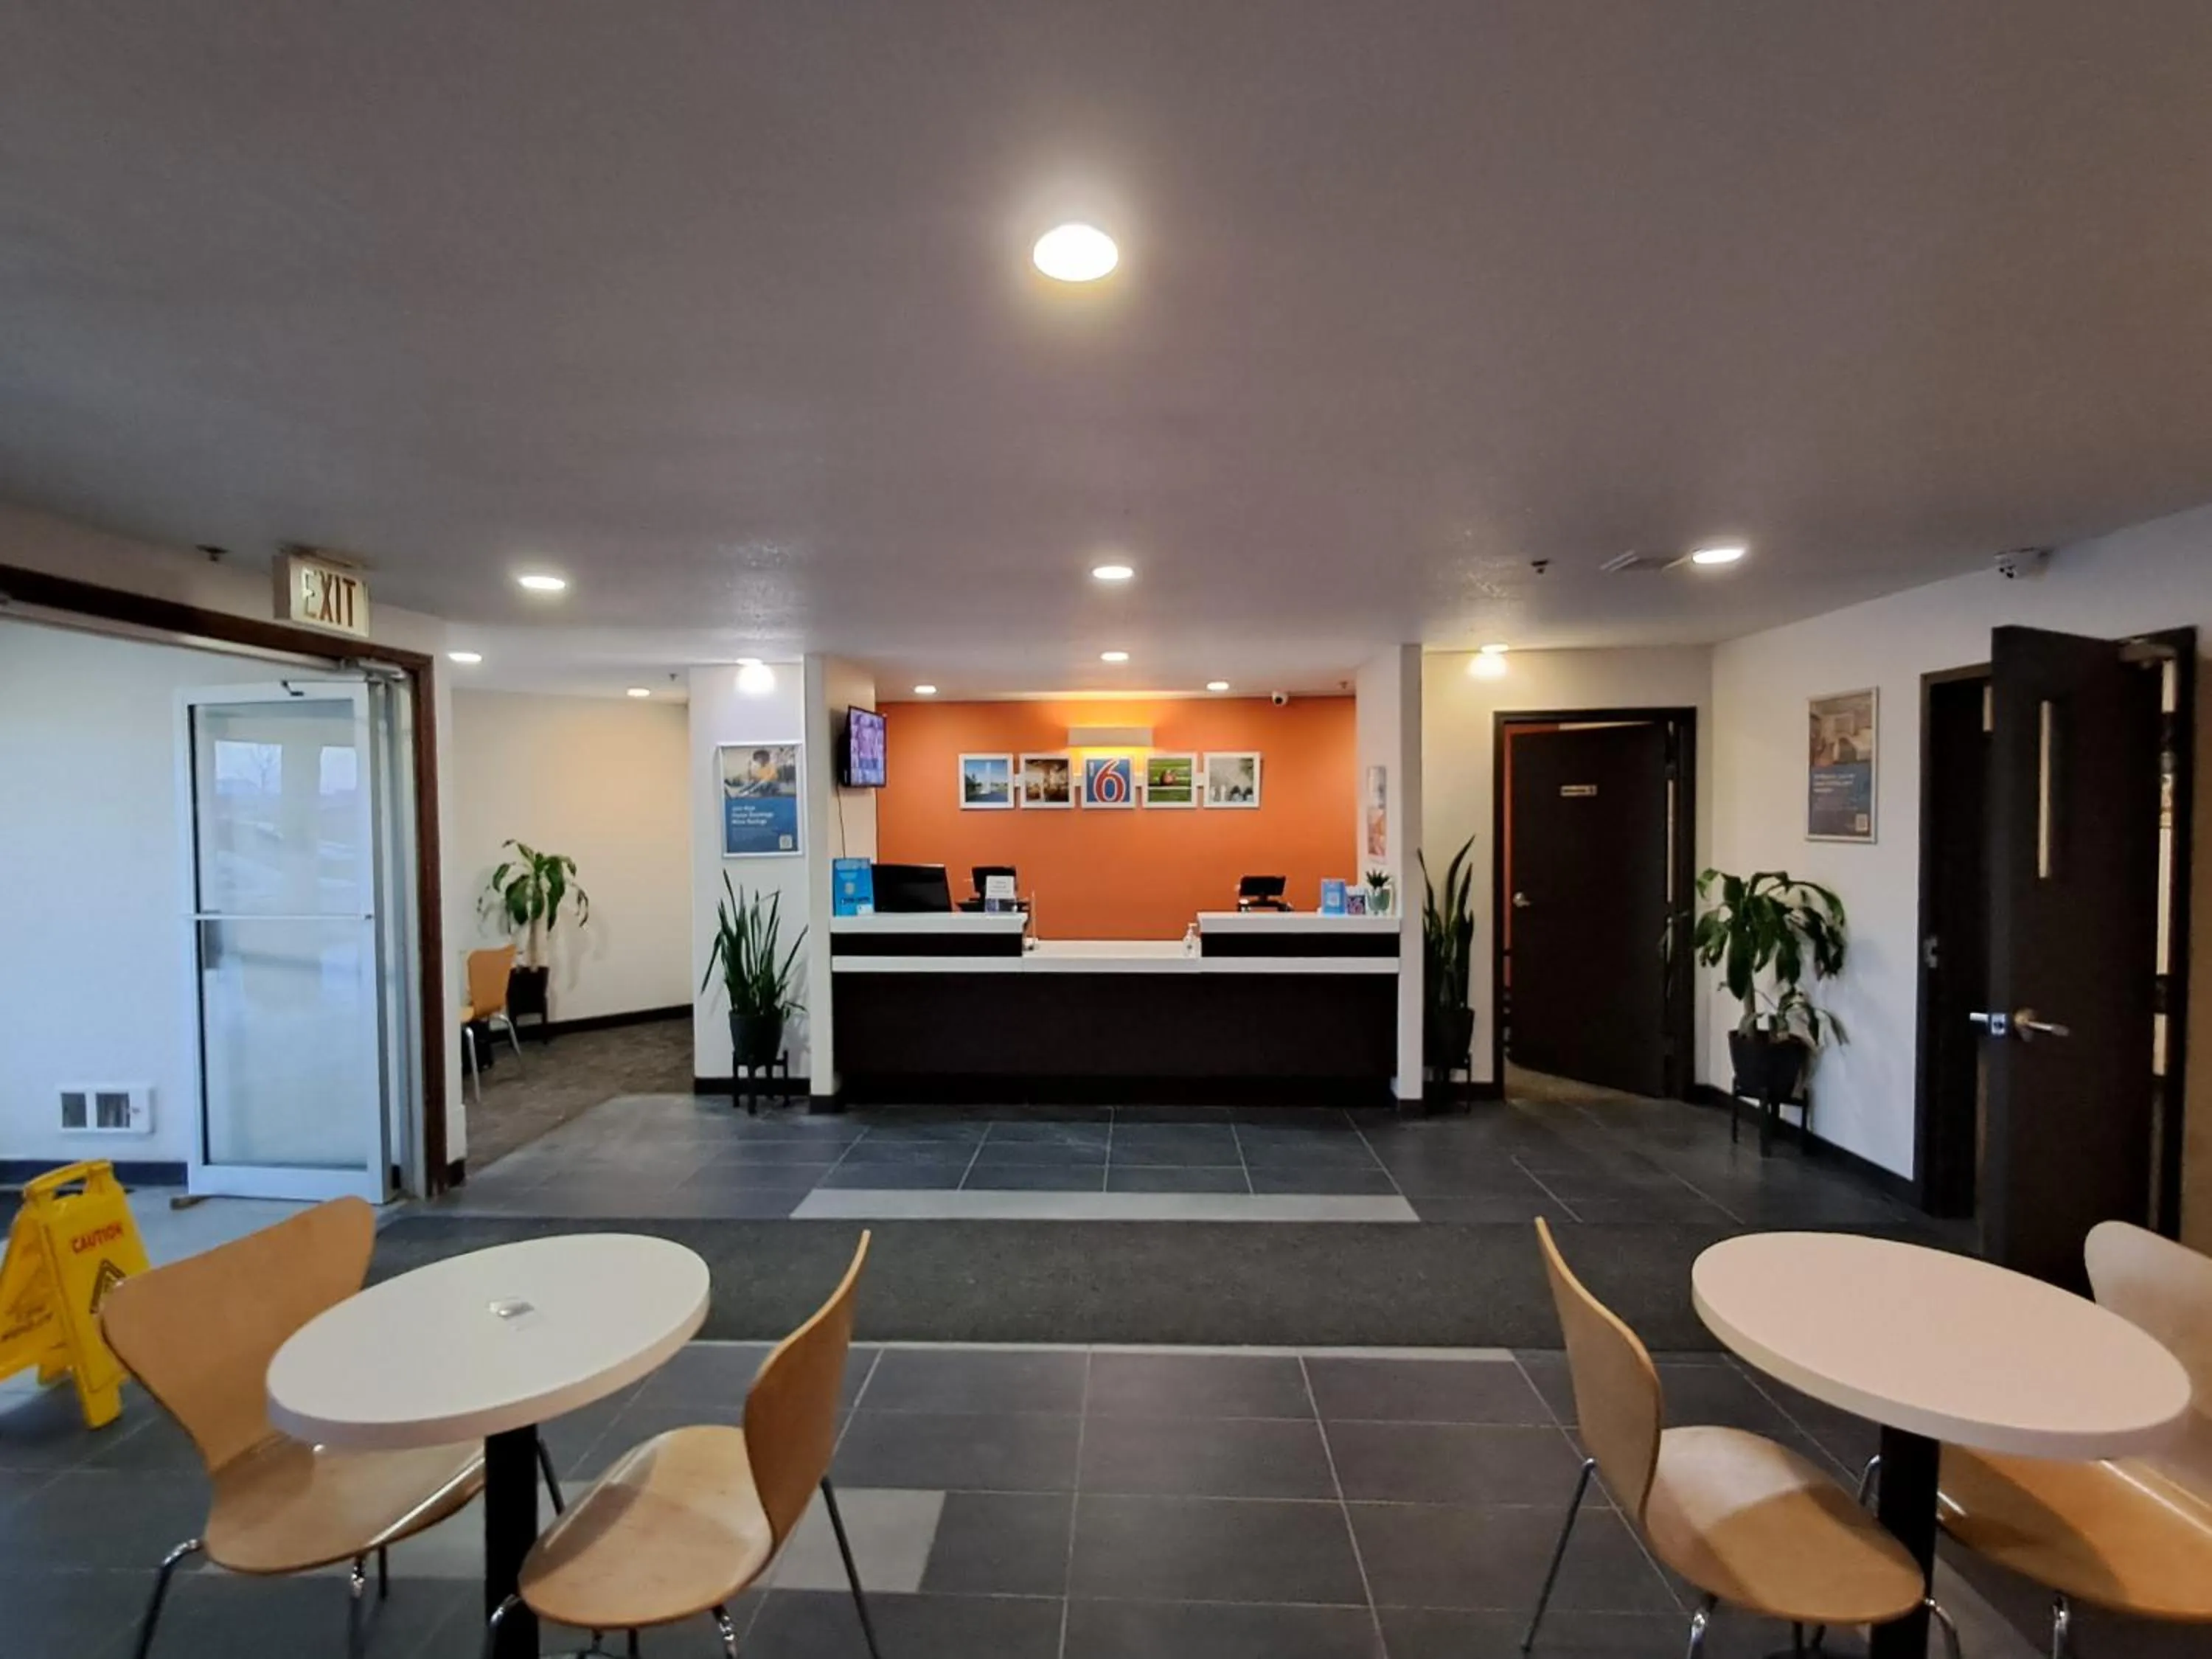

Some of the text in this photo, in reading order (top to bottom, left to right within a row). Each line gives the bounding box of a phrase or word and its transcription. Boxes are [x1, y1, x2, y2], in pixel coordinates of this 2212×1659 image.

[302, 566, 356, 627] EXIT
[1093, 758, 1126, 802] 6
[72, 1221, 123, 1253] CAUTION
